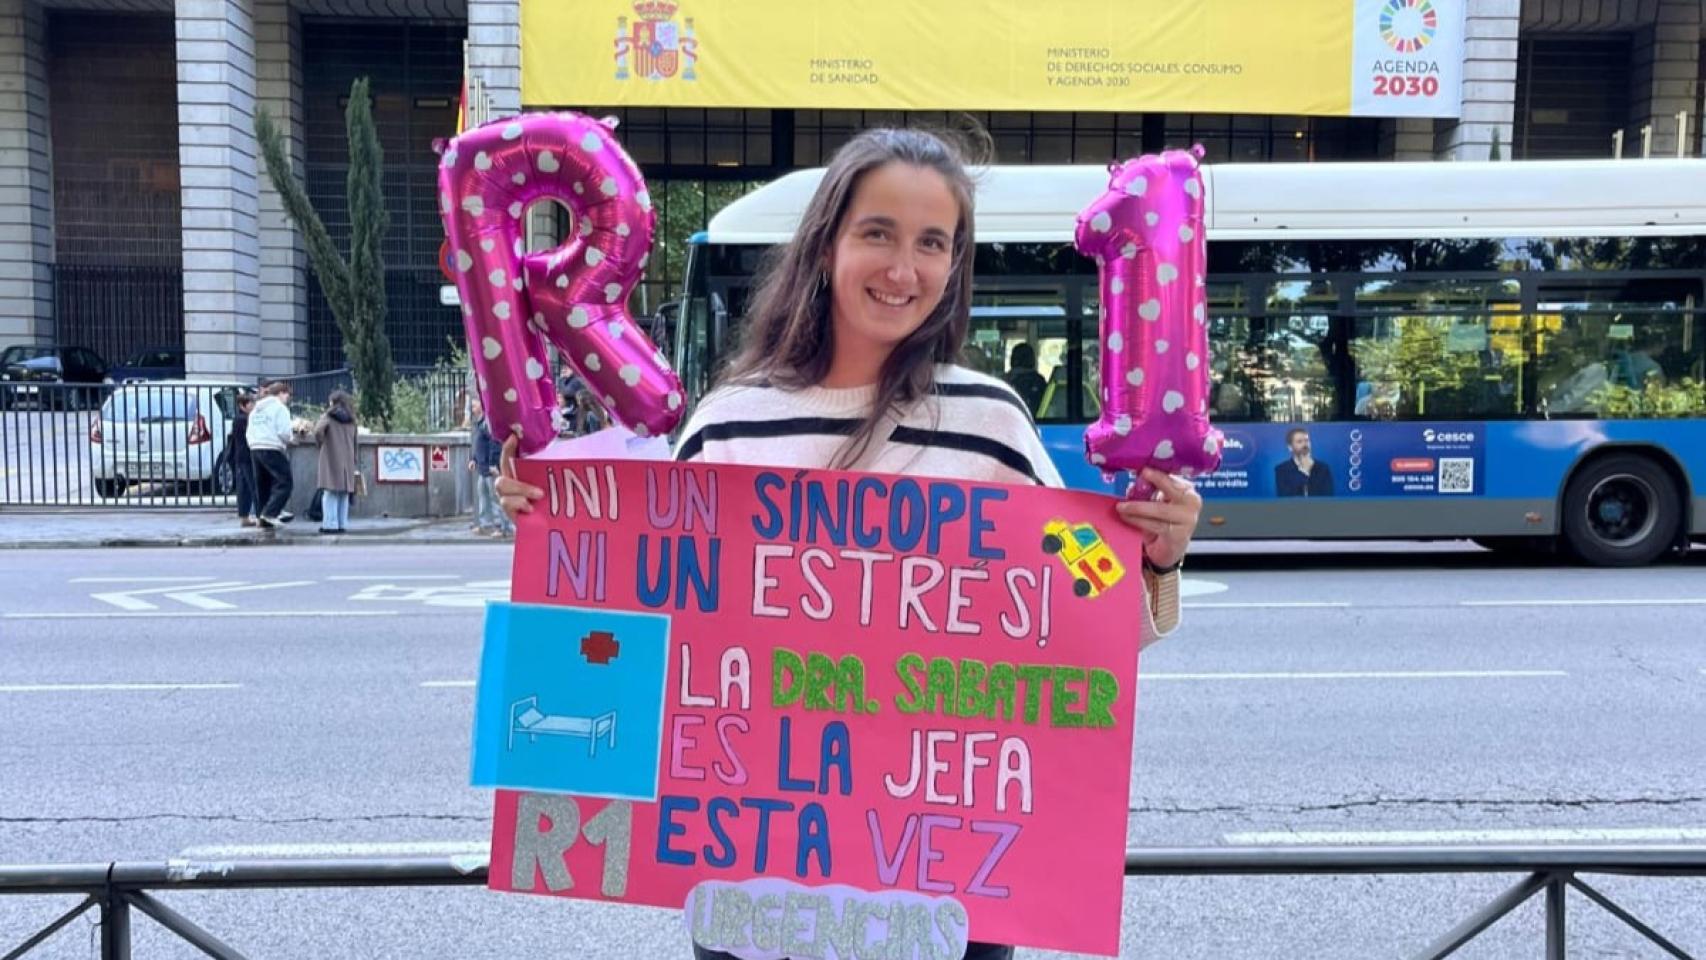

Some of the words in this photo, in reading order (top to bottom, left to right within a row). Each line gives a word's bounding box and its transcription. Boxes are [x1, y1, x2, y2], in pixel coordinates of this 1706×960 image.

[1047, 48, 1109, 58] MINISTERIO
[810, 59, 873, 69] MINISTERIO
[1047, 62, 1061, 72] DE
[1064, 62, 1125, 73] DERECHOS
[1183, 63, 1242, 74] CONSUMO
[1372, 60, 1440, 73] AGENDA
[810, 73, 824, 84] DE
[828, 73, 879, 84] SANIDAD
[1047, 77, 1053, 86] Y
[1056, 77, 1103, 87] AGENDA
[1106, 77, 1130, 87] 2030
[1373, 75, 1439, 96] 2030
[1437, 432, 1474, 442] cesce
[547, 465, 618, 521] ¡NI
[646, 467, 719, 534] UN
[751, 470, 1008, 560] SÍNCOPE
[546, 529, 608, 601] NI
[636, 533, 721, 613] UN
[752, 544, 1051, 648] ESTRÉS!
[680, 642, 752, 711] LA
[771, 647, 881, 715] DRA.
[893, 653, 1120, 729] SABATER
[669, 714, 750, 786] ES
[778, 716, 853, 796] LA
[883, 729, 1033, 814] JEFA
[511, 792, 632, 897] R1
[655, 795, 832, 878] ESTA
[866, 809, 1022, 898] VEZ
[692, 884, 966, 960] URGENCIAS
